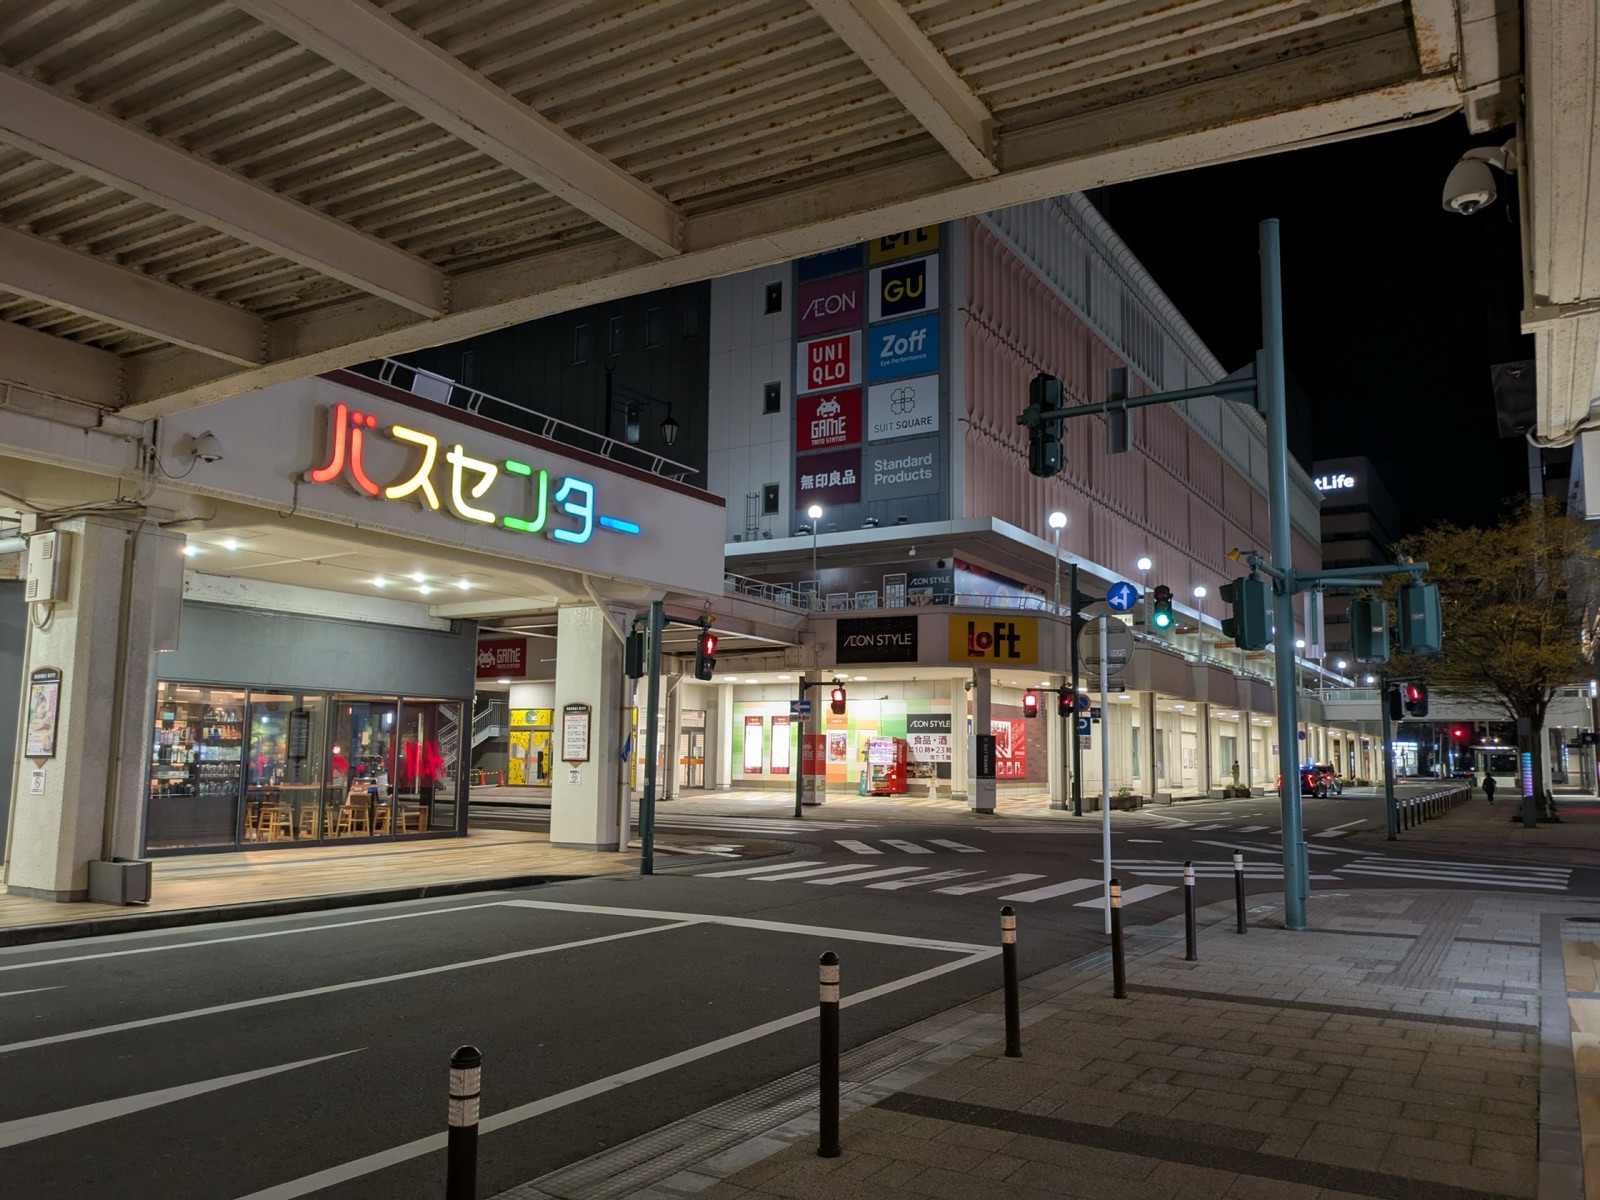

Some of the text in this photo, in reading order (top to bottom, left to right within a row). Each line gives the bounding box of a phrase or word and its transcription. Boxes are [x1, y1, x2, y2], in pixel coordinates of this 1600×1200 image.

[884, 274, 923, 302] GU
[812, 342, 842, 364] UNI
[880, 328, 926, 358] Zoff
[880, 353, 927, 368] Eye Performance
[812, 362, 845, 384] QLO
[811, 416, 846, 438] GAME
[874, 415, 932, 434] SUIT SQUARE
[811, 435, 846, 446] TAITO STATION
[874, 452, 932, 472] Standard
[311, 402, 640, 544] バスセンター
[800, 470, 856, 490] 無印良品
[874, 468, 932, 486] Products
[929, 576, 950, 584] STYLE
[876, 634, 912, 646] STYLE
[496, 648, 521, 664] GAME
